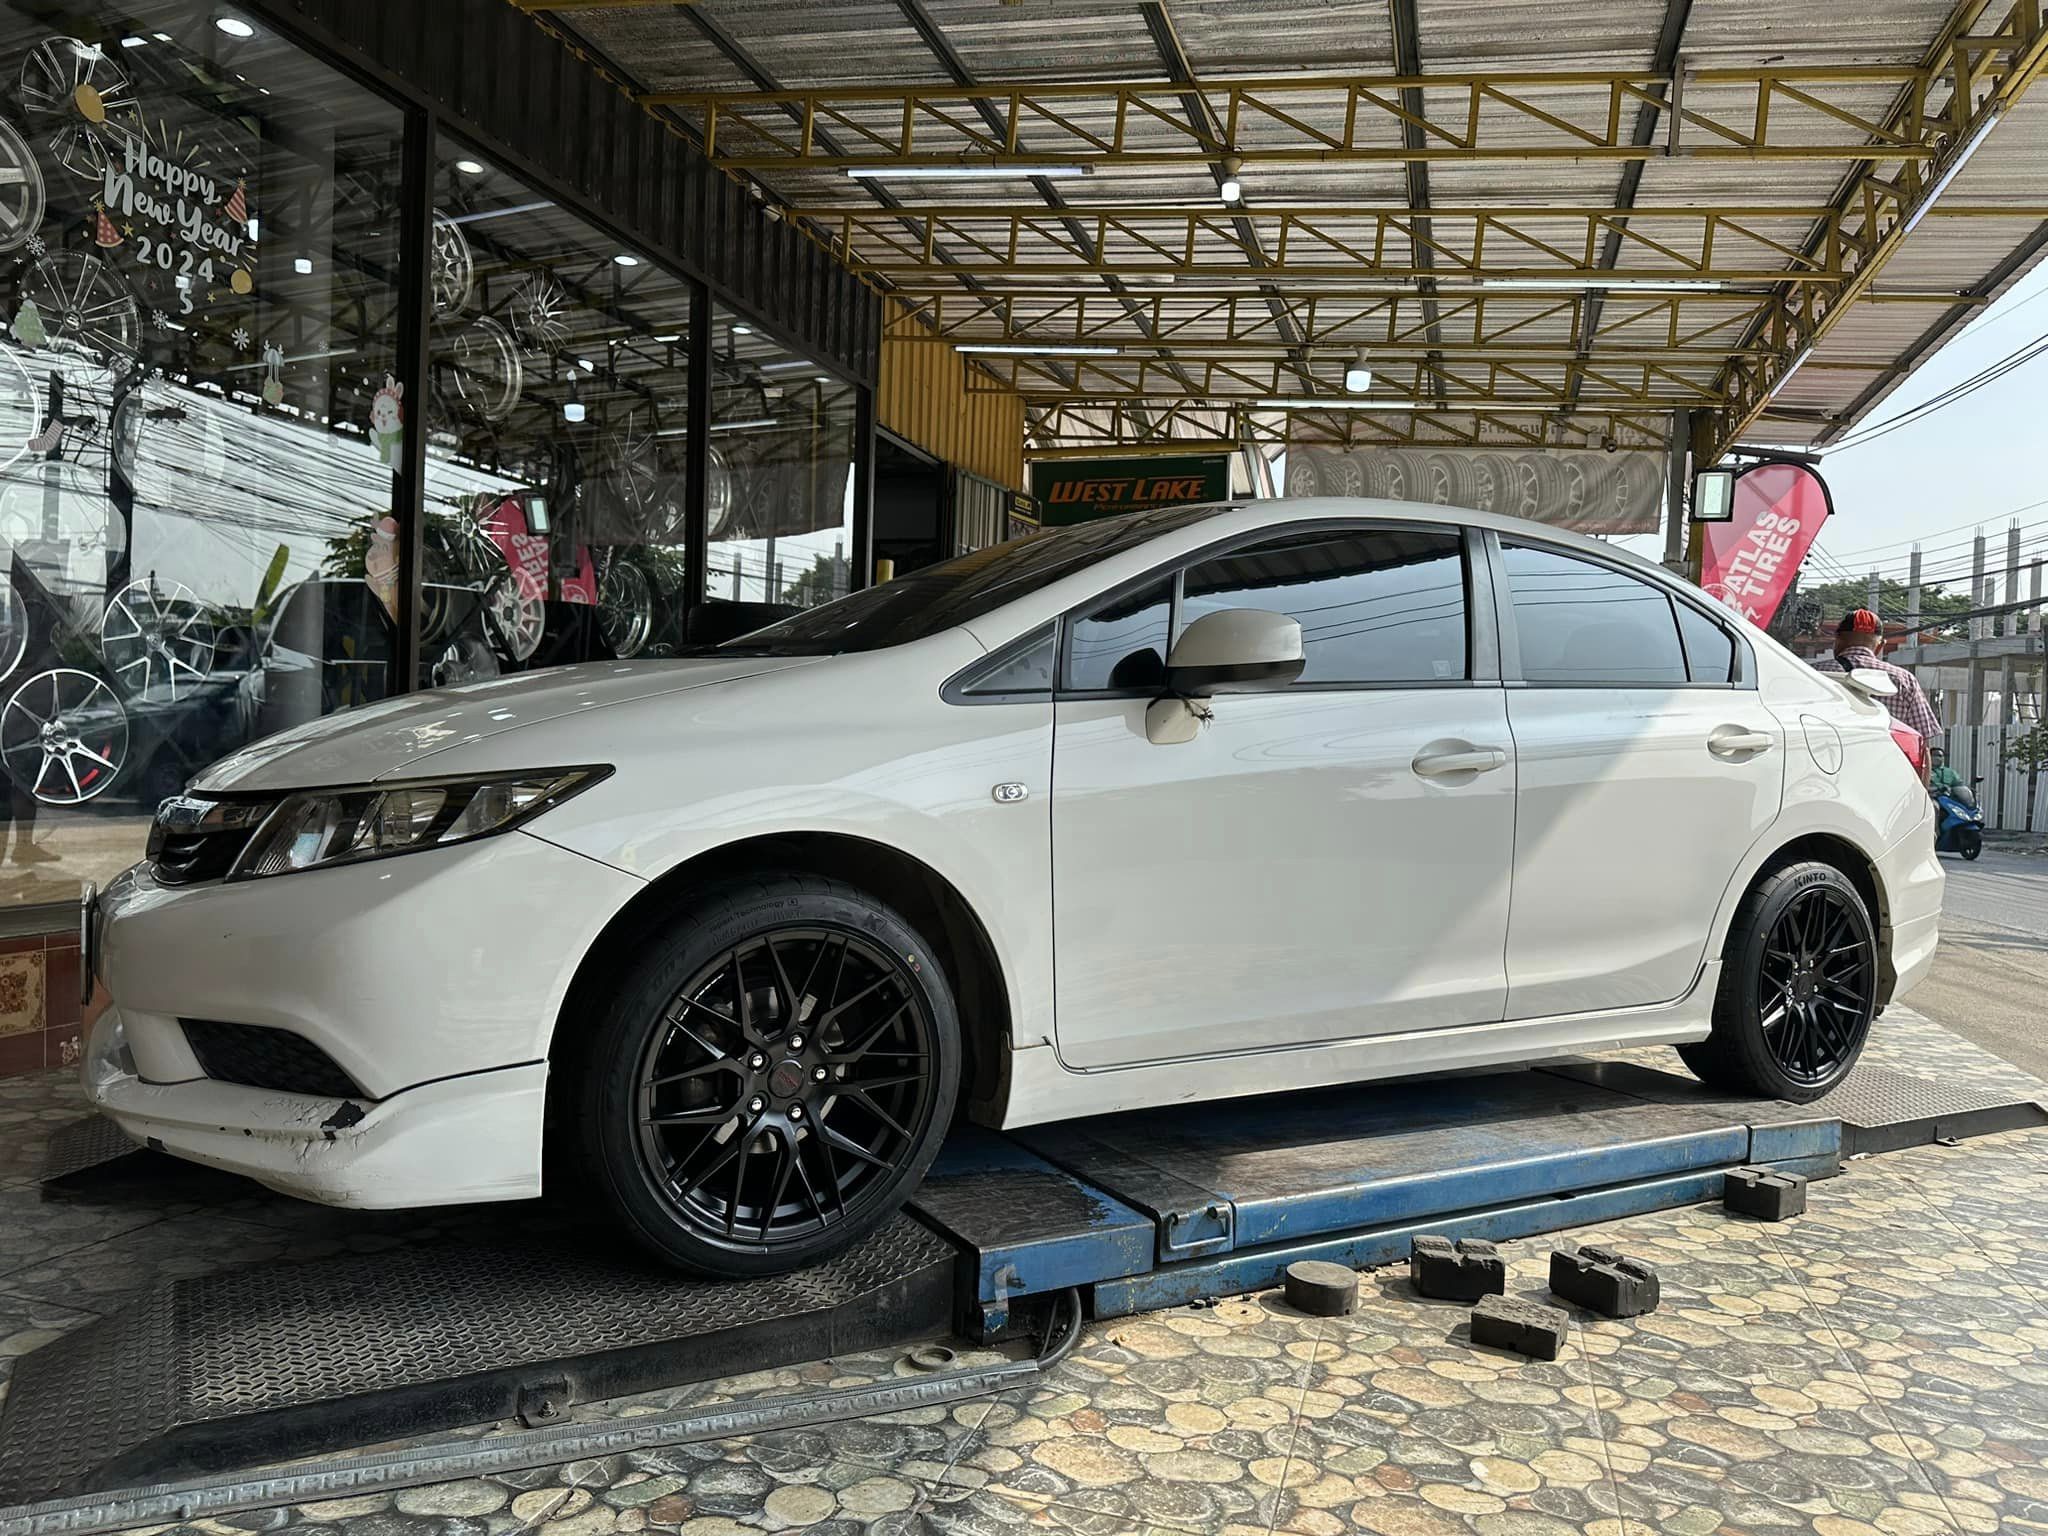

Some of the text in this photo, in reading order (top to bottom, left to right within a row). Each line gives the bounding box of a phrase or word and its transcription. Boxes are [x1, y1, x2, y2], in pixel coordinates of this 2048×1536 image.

[124, 135, 221, 204] Happy
[104, 163, 244, 256] New Year
[137, 236, 214, 283] 2024
[180, 288, 193, 314] 5
[1048, 479, 1206, 503] WEST LAKE
[1723, 511, 1779, 594] ATLAS
[1742, 516, 1800, 598] TIRES
[1794, 872, 1826, 888] KINTO
